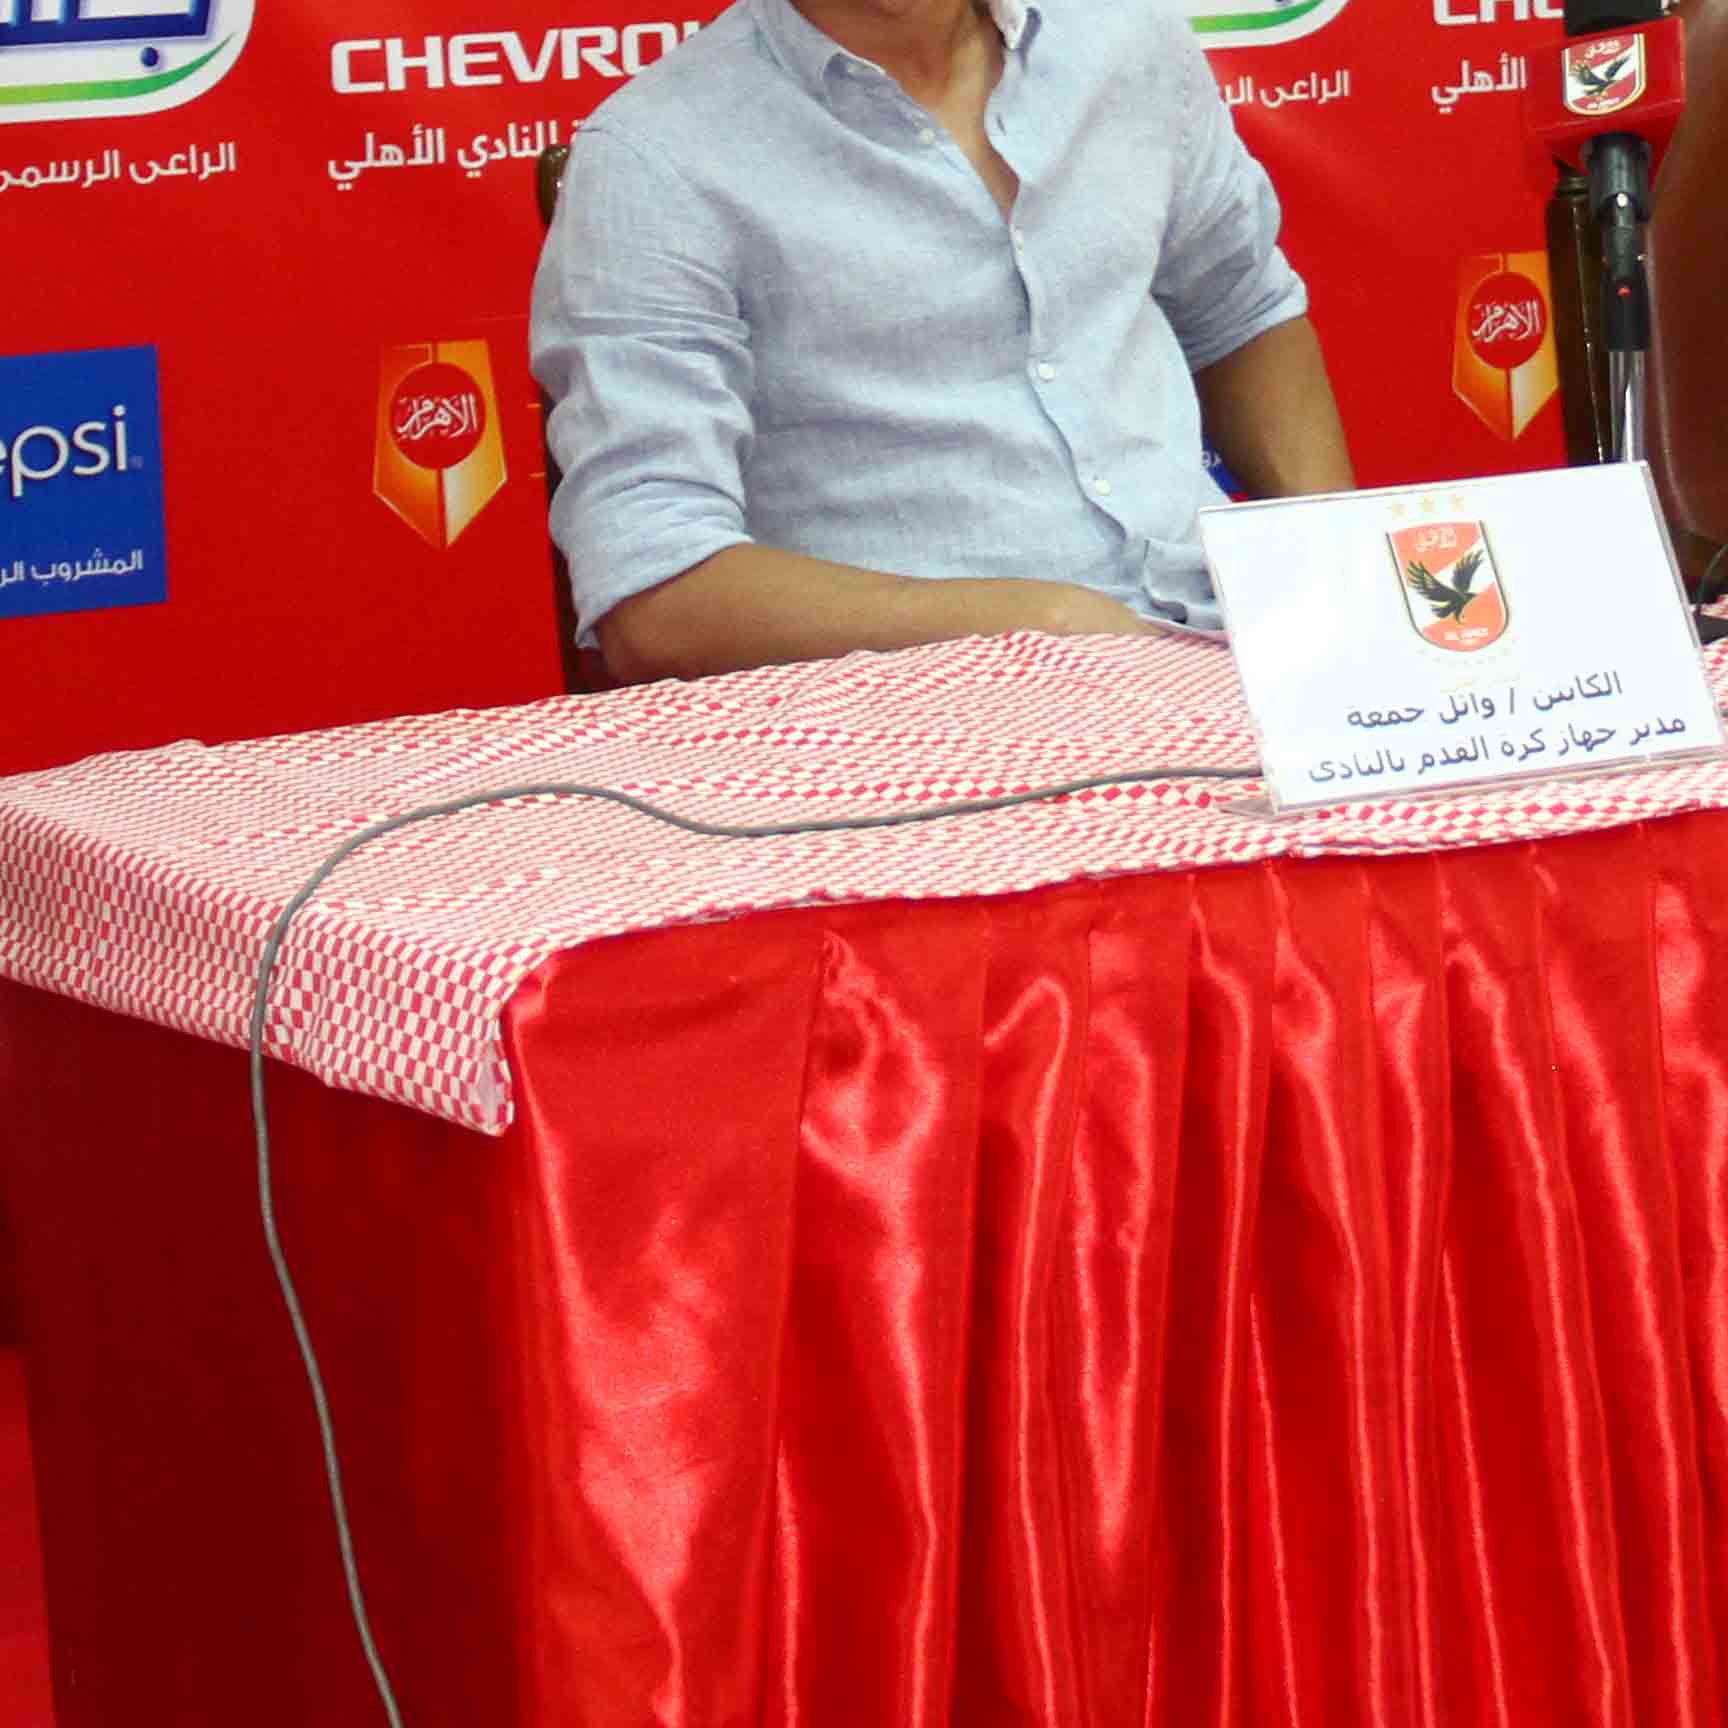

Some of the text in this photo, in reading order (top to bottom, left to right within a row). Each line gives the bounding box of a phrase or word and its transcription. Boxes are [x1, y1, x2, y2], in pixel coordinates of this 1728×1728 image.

[1432, 53, 1526, 113] الأهلي
[129, 142, 235, 184] الراعى
[328, 124, 445, 190] الأهلي
